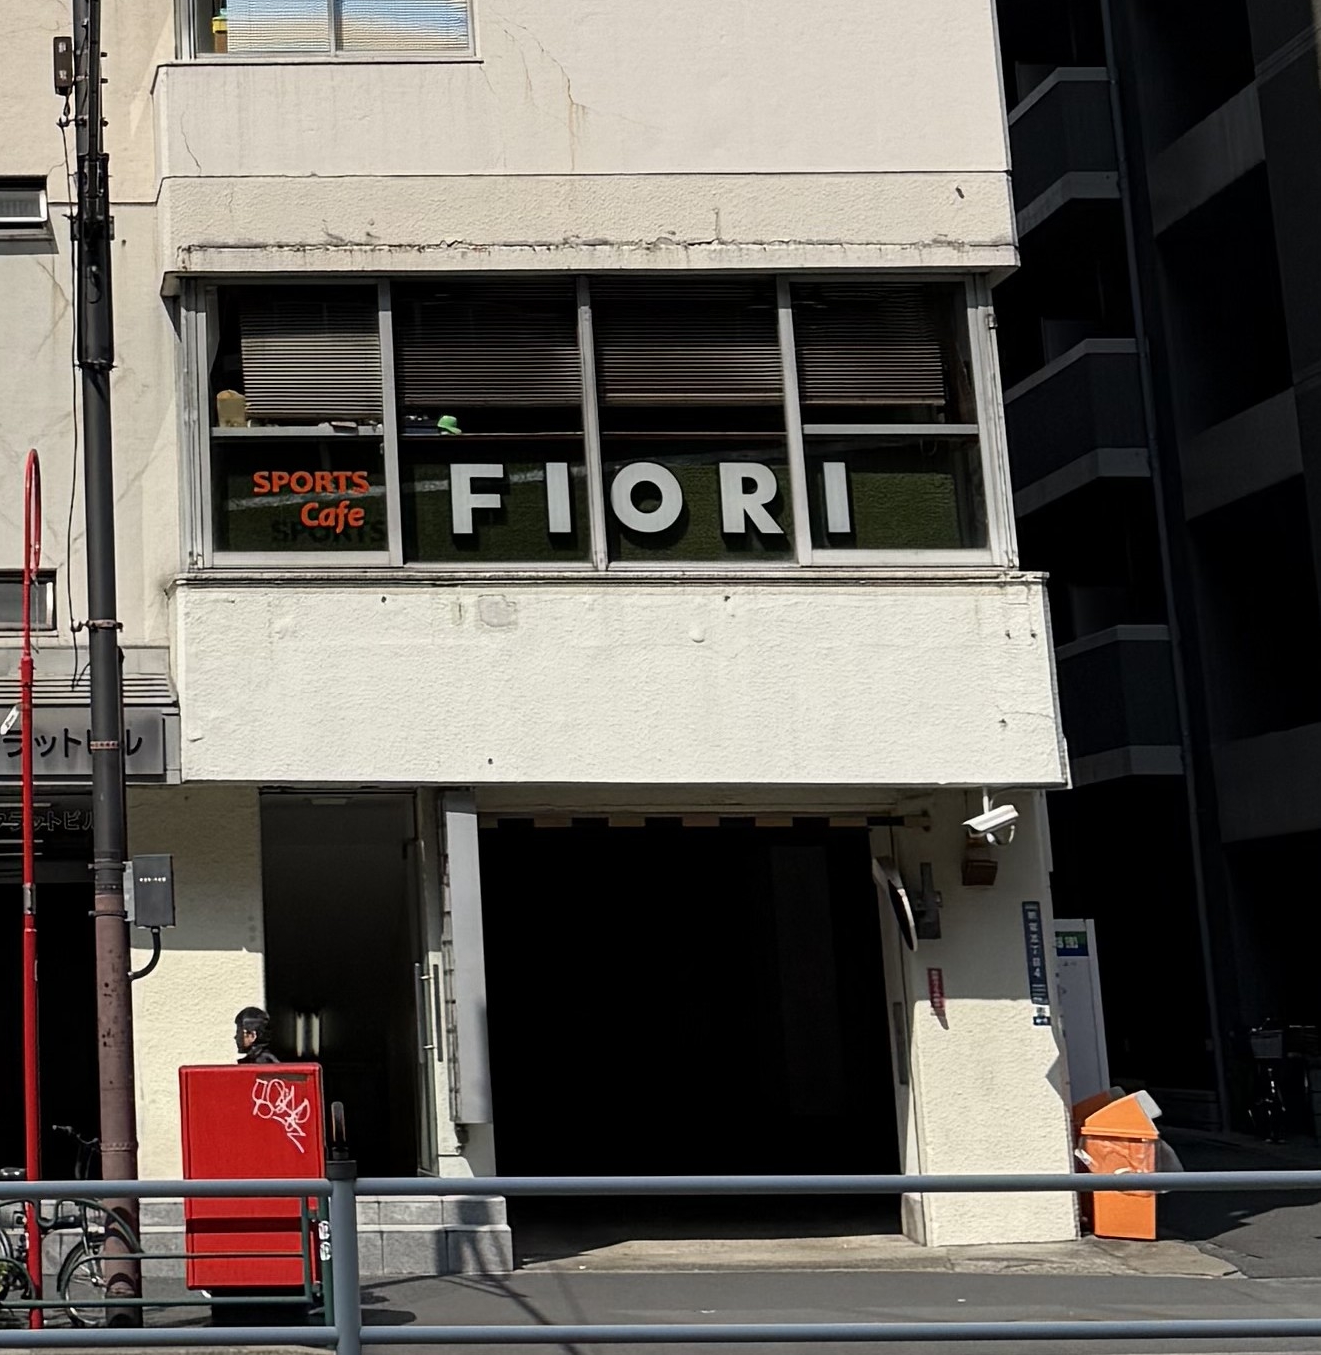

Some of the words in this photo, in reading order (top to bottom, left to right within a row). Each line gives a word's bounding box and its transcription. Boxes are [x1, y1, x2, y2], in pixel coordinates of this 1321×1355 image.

[253, 471, 370, 494] SPORTS
[449, 461, 852, 536] FIORI
[301, 500, 365, 534] Cafe
